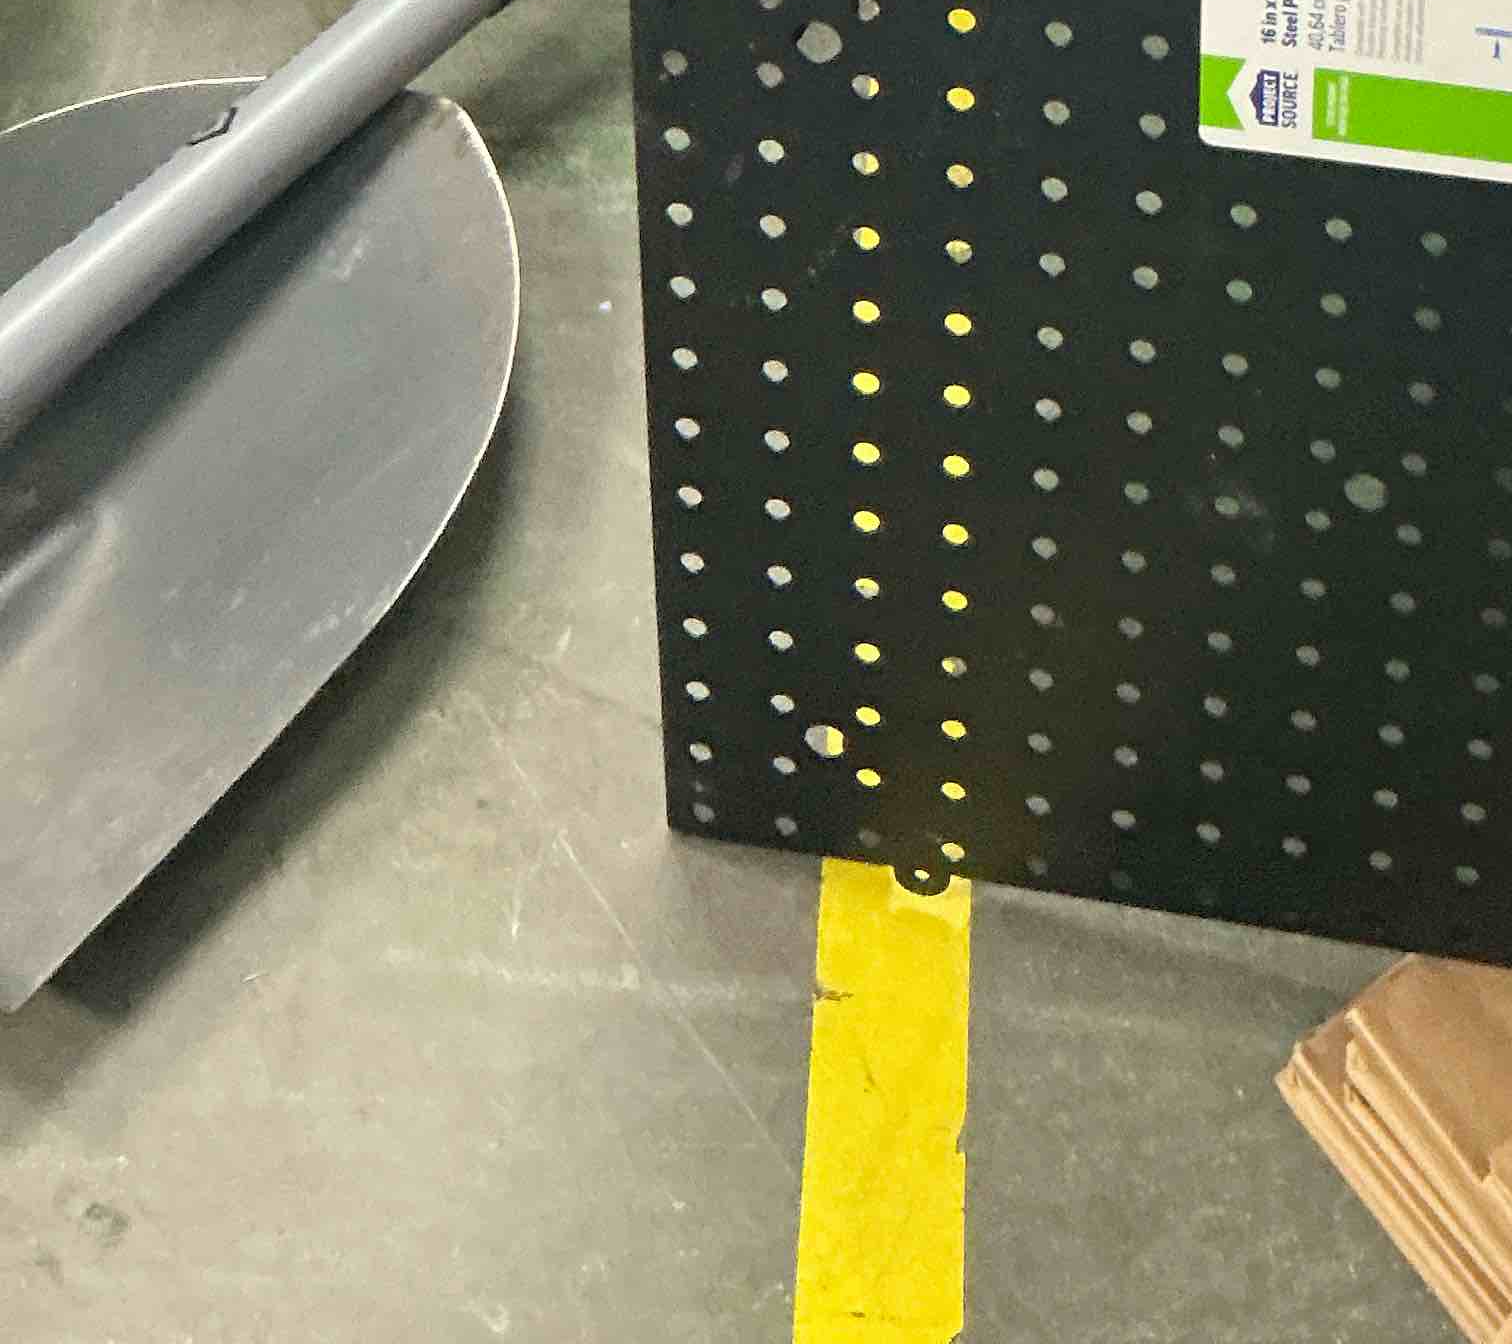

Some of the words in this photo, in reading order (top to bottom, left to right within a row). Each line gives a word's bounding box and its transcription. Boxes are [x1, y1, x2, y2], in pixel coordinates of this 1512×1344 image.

[1266, 0, 1278, 10] x
[1261, 12, 1277, 26] in
[1261, 28, 1277, 44] 16
[1282, 12, 1298, 48] Steel
[1280, 72, 1298, 129] SOURCE
